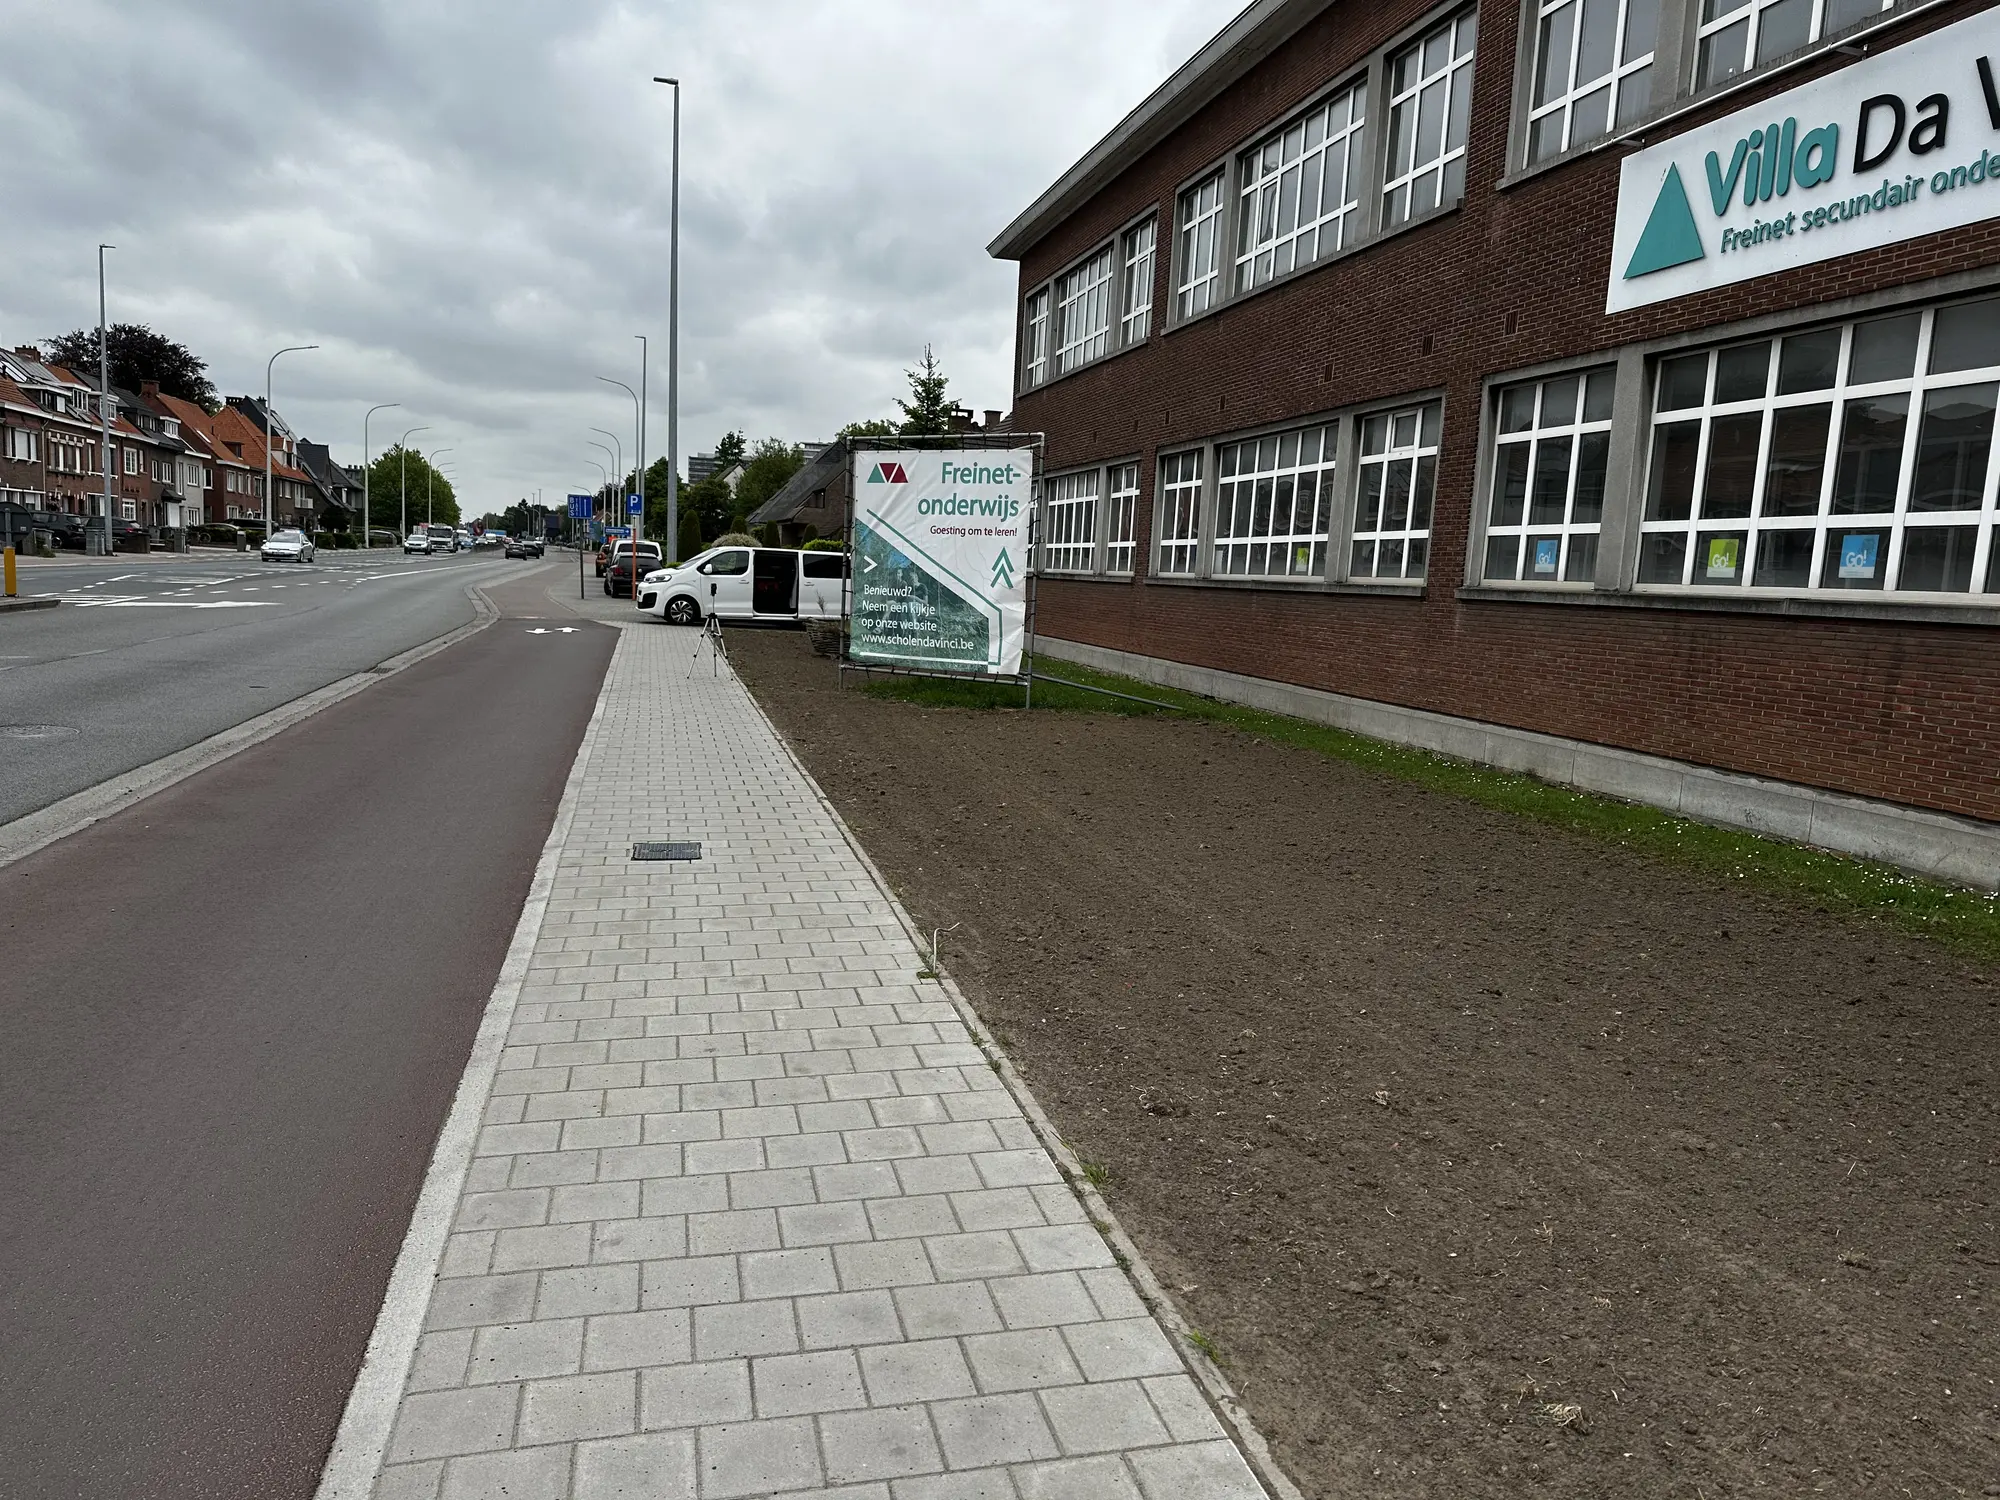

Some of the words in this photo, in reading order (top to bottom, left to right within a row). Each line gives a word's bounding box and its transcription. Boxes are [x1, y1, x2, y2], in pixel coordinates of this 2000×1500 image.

[1705, 117, 1839, 216] Villa
[1852, 93, 1949, 173] Da
[1720, 211, 1795, 253] Freinet
[1799, 175, 1924, 231] secundair
[942, 462, 1021, 484] Freinet-
[630, 495, 638, 507] P
[917, 492, 1019, 522] onderwijs
[930, 525, 966, 537] Goesting
[967, 528, 982, 536] om
[984, 527, 993, 536] te
[994, 527, 1018, 536] leren!
[864, 584, 912, 597] Benieuwd?
[862, 600, 888, 612] Neem
[890, 603, 908, 613] een
[910, 602, 936, 617] kijkje
[861, 618, 874, 629] op
[875, 619, 898, 629] onze
[899, 620, 937, 631] website
[861, 634, 974, 650] www.scholendavinci.be
